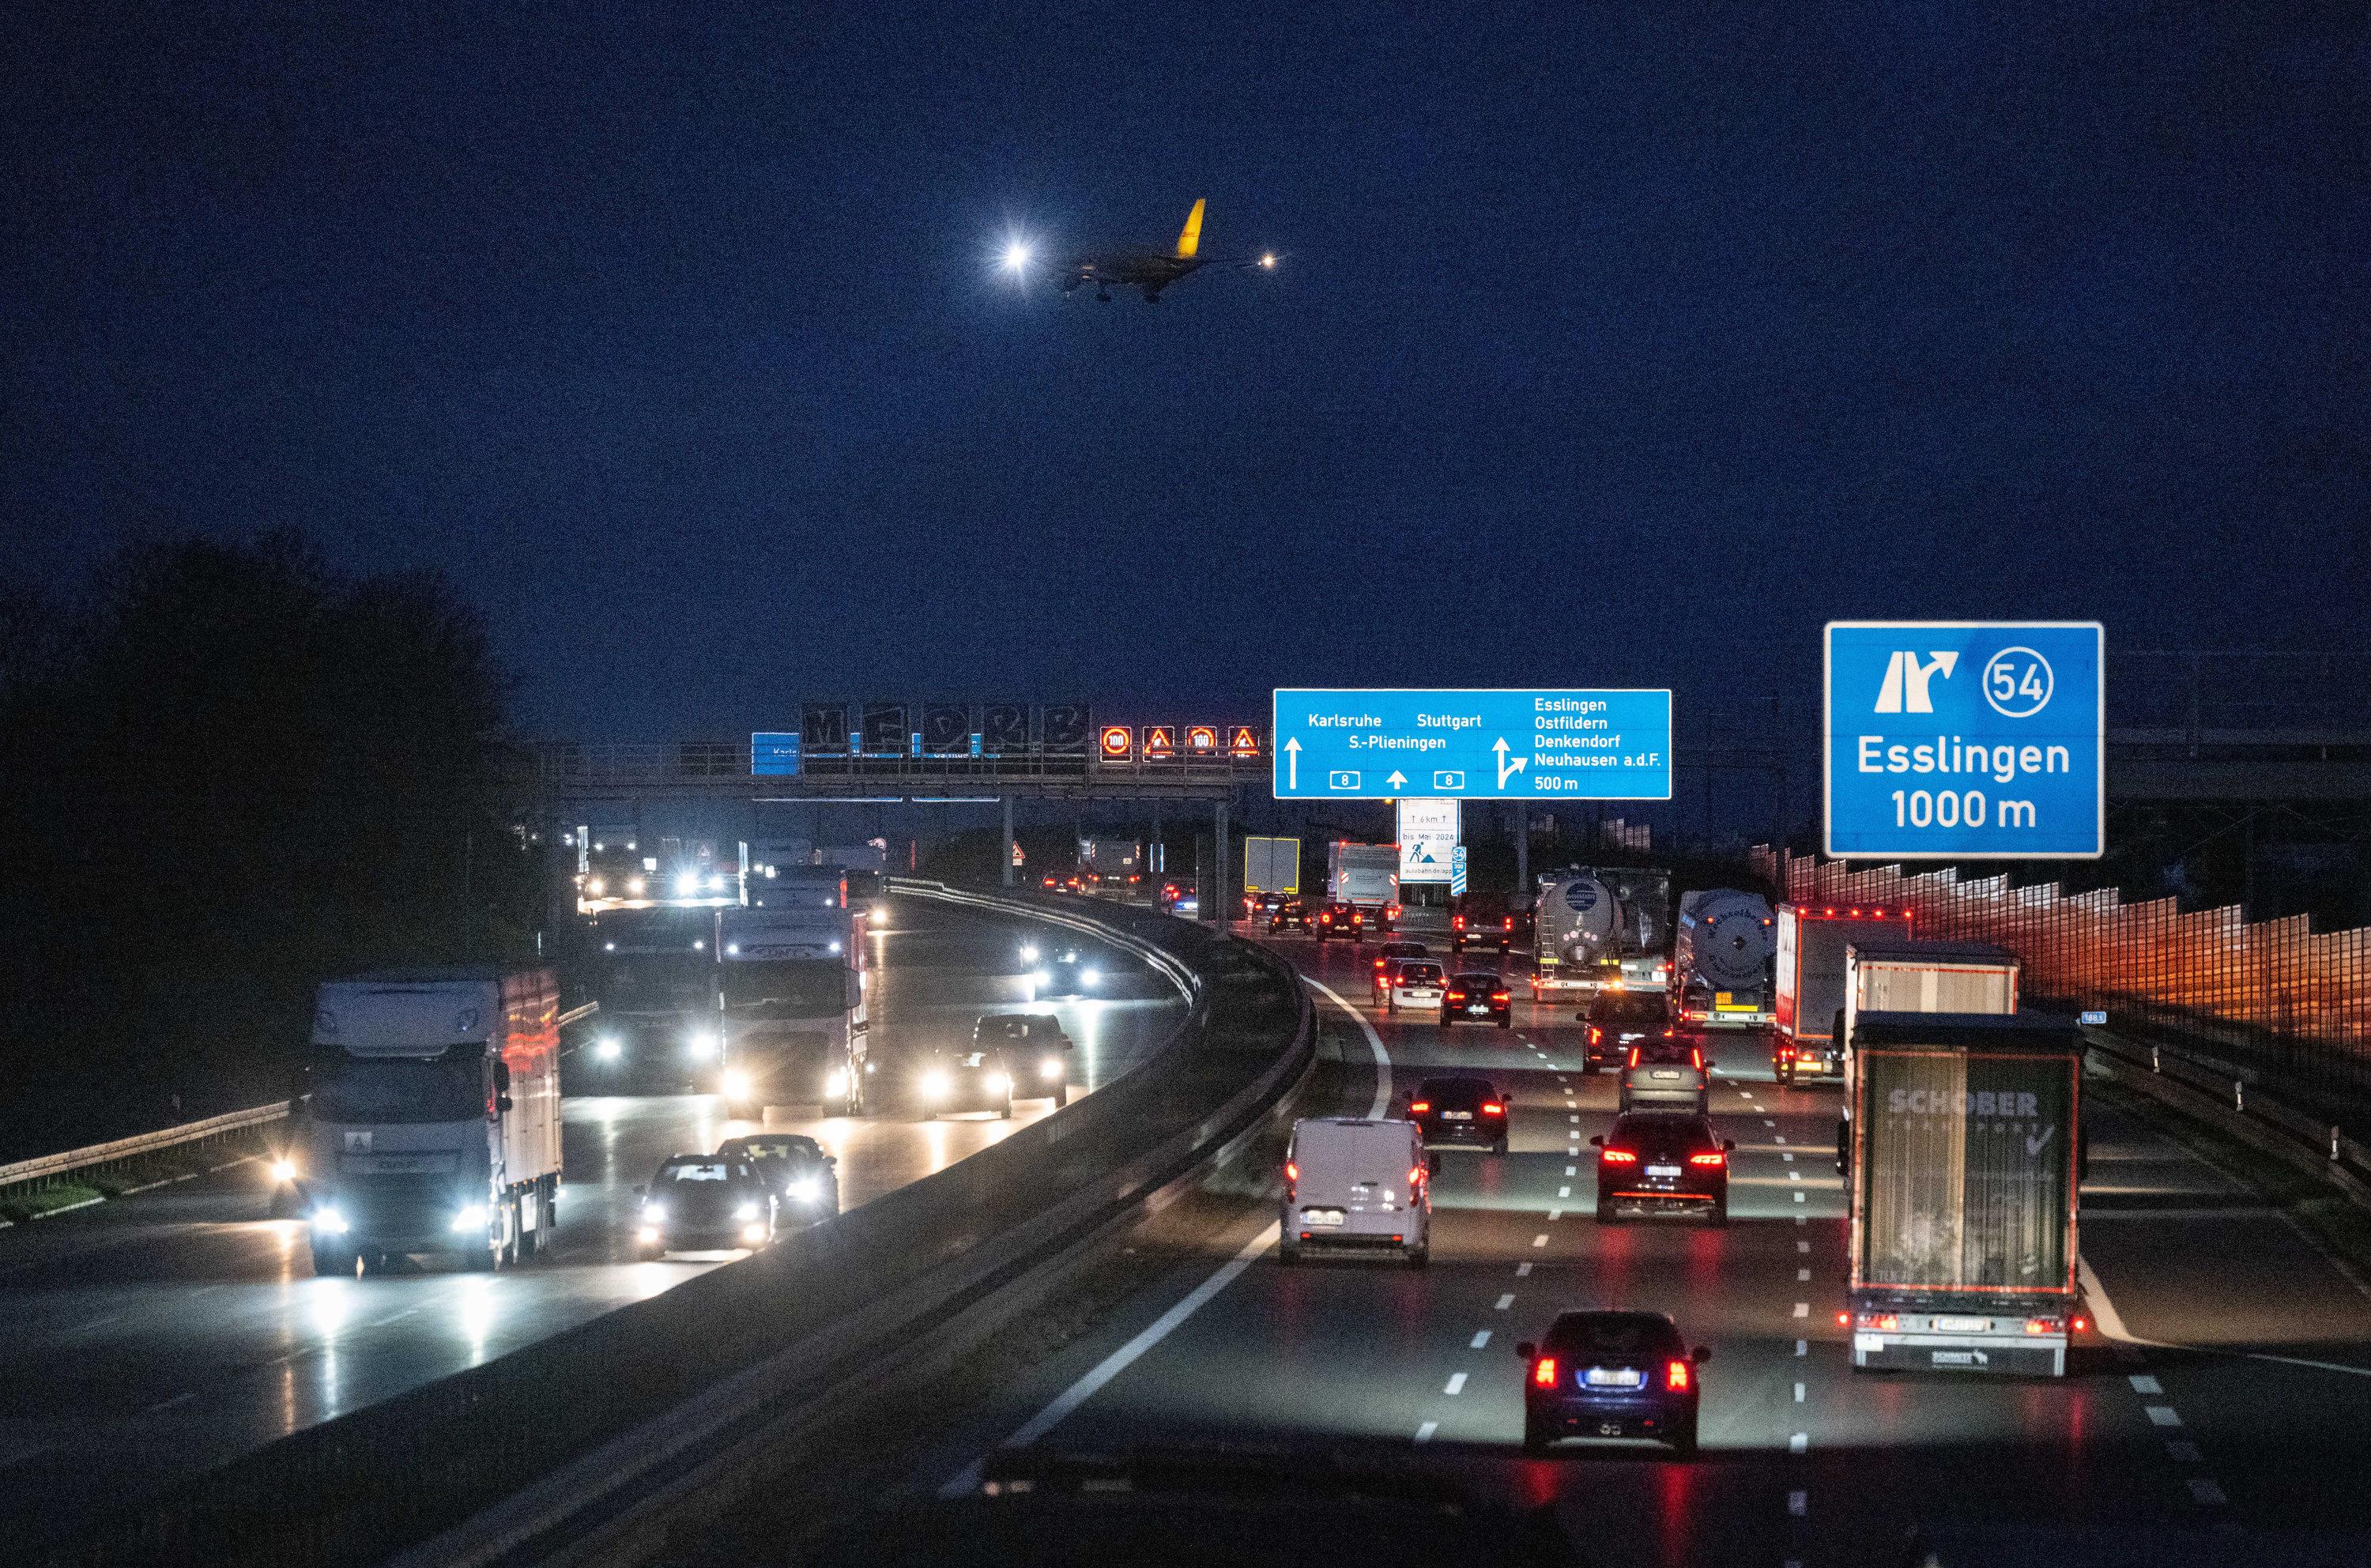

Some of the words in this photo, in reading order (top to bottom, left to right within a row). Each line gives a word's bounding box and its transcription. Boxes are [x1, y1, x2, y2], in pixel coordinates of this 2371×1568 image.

[1993, 663, 2044, 702] 54
[1535, 698, 1607, 714] Esslingen
[1309, 714, 1382, 727] Karlsruhe
[1417, 714, 1482, 730] Stuttgart
[1535, 716, 1608, 729] Ostfildern
[1108, 735, 1124, 747] 100
[1193, 735, 1209, 747] 100
[1349, 736, 1446, 752] S.-Plieningen
[1535, 735, 1620, 748] Denkendorf
[1535, 753, 1617, 767] Neuhausen
[1624, 753, 1660, 767] a.d.F.
[1858, 735, 2069, 783] Esslingen
[1342, 775, 1348, 786] 8
[1446, 775, 1453, 786] 8
[1535, 777, 1562, 790] 500
[1565, 780, 1578, 790] m
[1891, 790, 1986, 827] 1000
[1998, 800, 2036, 827] m
[1453, 849, 1464, 858] 54
[1888, 1088, 2037, 1117] SCHOBER
